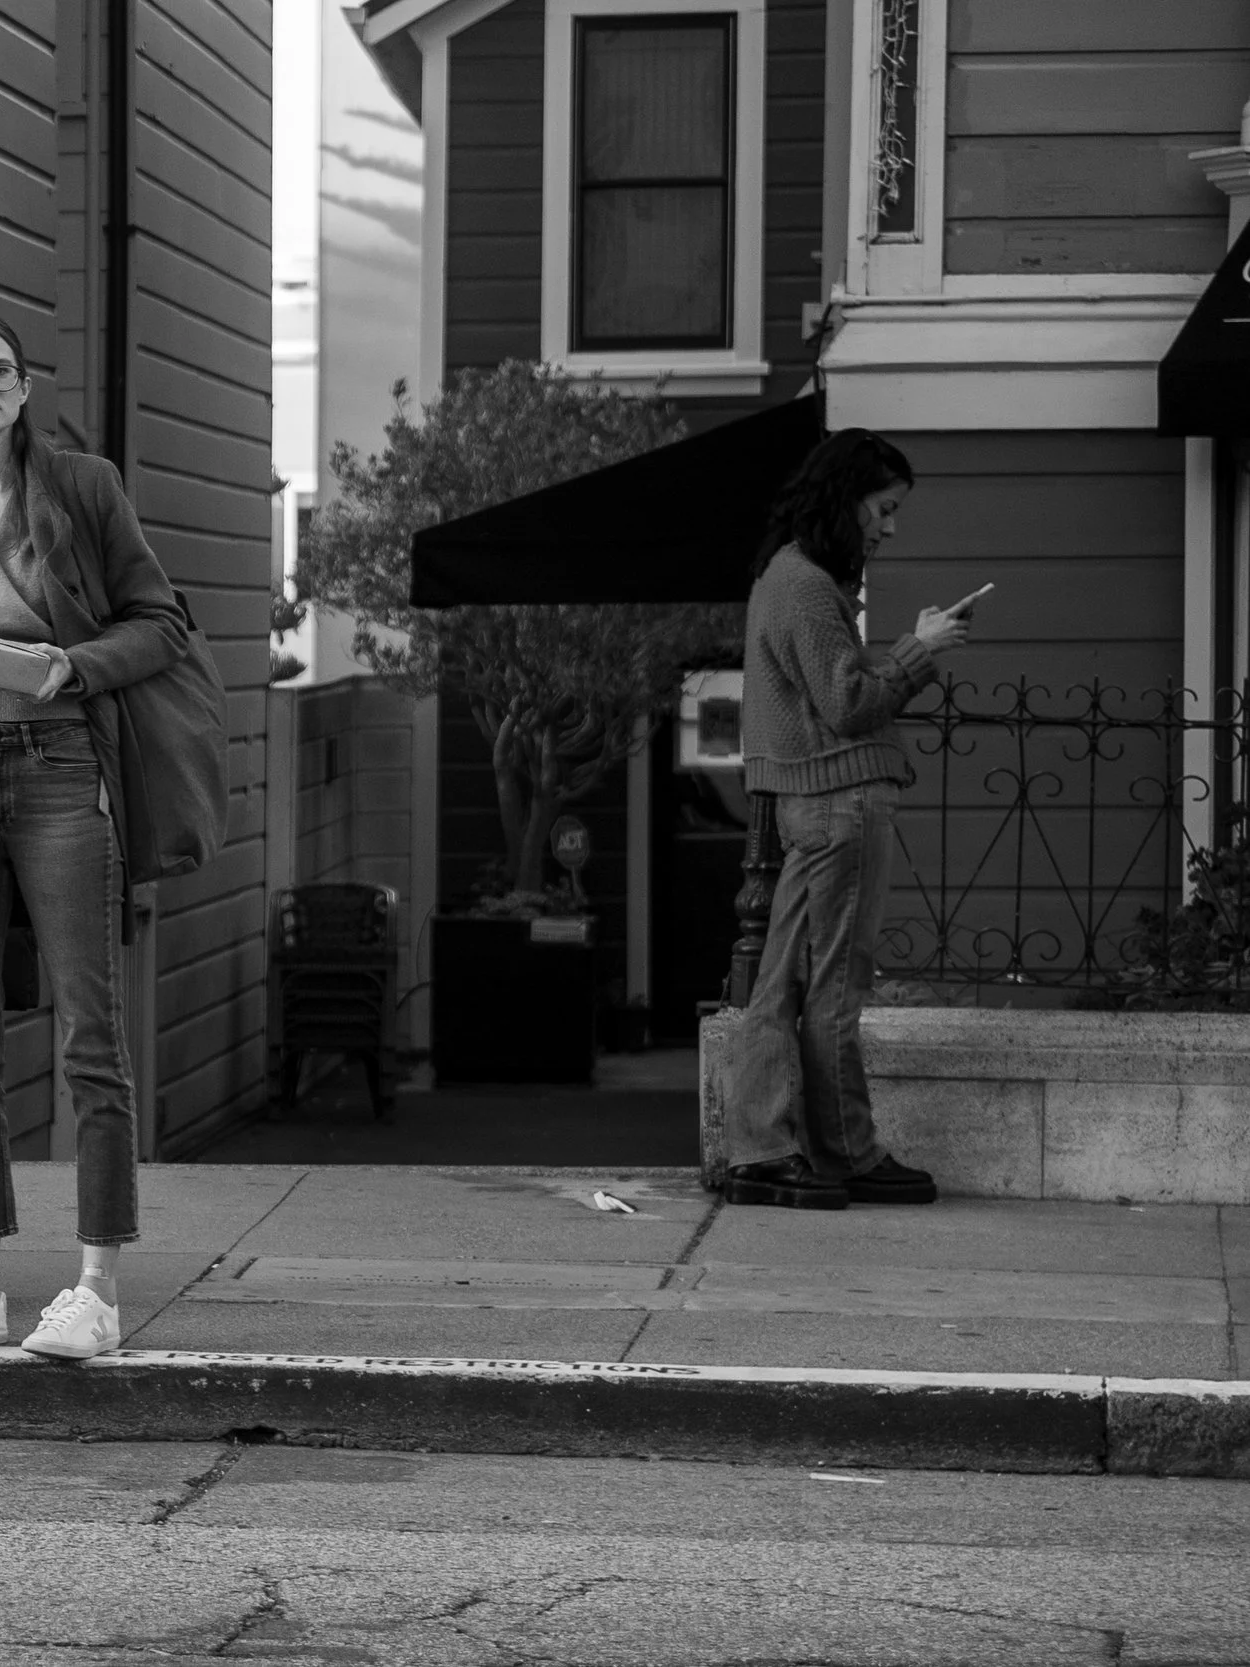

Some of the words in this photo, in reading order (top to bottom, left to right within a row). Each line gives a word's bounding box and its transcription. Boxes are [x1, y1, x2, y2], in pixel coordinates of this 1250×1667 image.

[557, 829, 583, 850] ADT
[166, 1352, 344, 1364] POSTED
[364, 1358, 701, 1375] RESTRICTIONS
